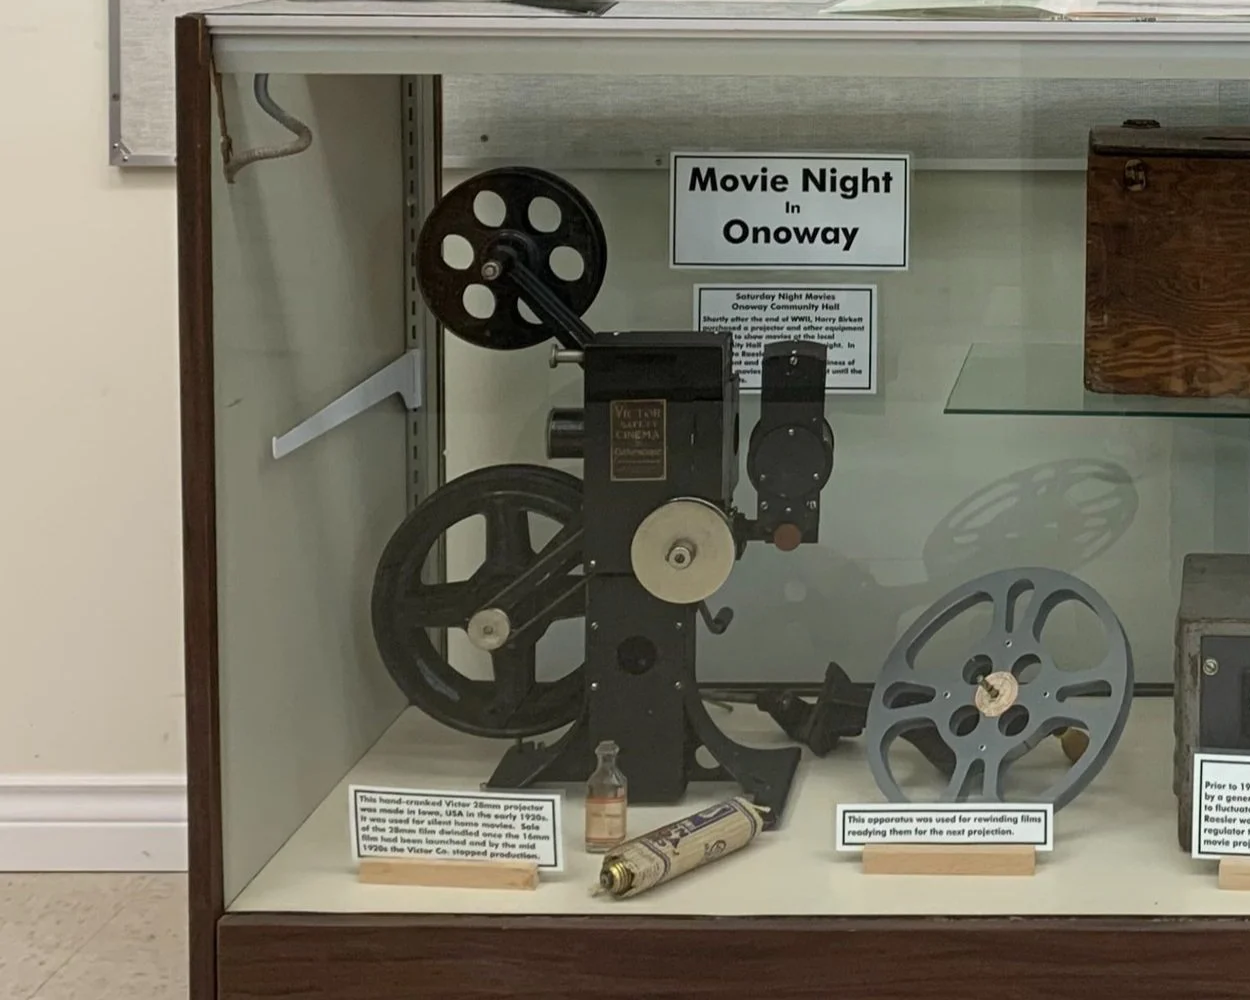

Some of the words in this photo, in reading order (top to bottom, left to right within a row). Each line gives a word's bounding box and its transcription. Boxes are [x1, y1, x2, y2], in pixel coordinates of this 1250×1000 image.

[688, 167, 789, 192] Movie
[802, 167, 893, 200] Night
[785, 201, 801, 214] In
[722, 218, 859, 251] Onoway
[735, 292, 776, 303] Saturday
[778, 292, 803, 303] Night
[804, 292, 836, 300] Movies
[731, 303, 769, 313] Onoway
[770, 303, 820, 313] Community
[821, 303, 840, 311] Hall
[1204, 781, 1227, 791] Prior
[1228, 782, 1238, 791] to
[1204, 792, 1216, 805] by
[1217, 794, 1224, 802] a
[359, 795, 378, 804] This
[378, 796, 443, 807] hand-cranked
[444, 798, 471, 808] Victor
[472, 800, 502, 809] 28mm
[503, 801, 544, 814] projector
[1204, 803, 1214, 813] to
[847, 815, 866, 824] This
[867, 815, 914, 826] apparatus
[935, 815, 957, 823] used
[958, 815, 972, 823] for
[973, 815, 1019, 826] rewinding
[1020, 815, 1042, 823] films
[1204, 814, 1238, 825] Roesler
[847, 828, 887, 839] readying
[889, 828, 913, 836] them
[914, 827, 928, 836] for
[929, 827, 944, 836] the
[945, 827, 966, 836] next
[967, 827, 1015, 839] projection.
[1203, 826, 1246, 839] regulator
[1203, 837, 1231, 847] movie
